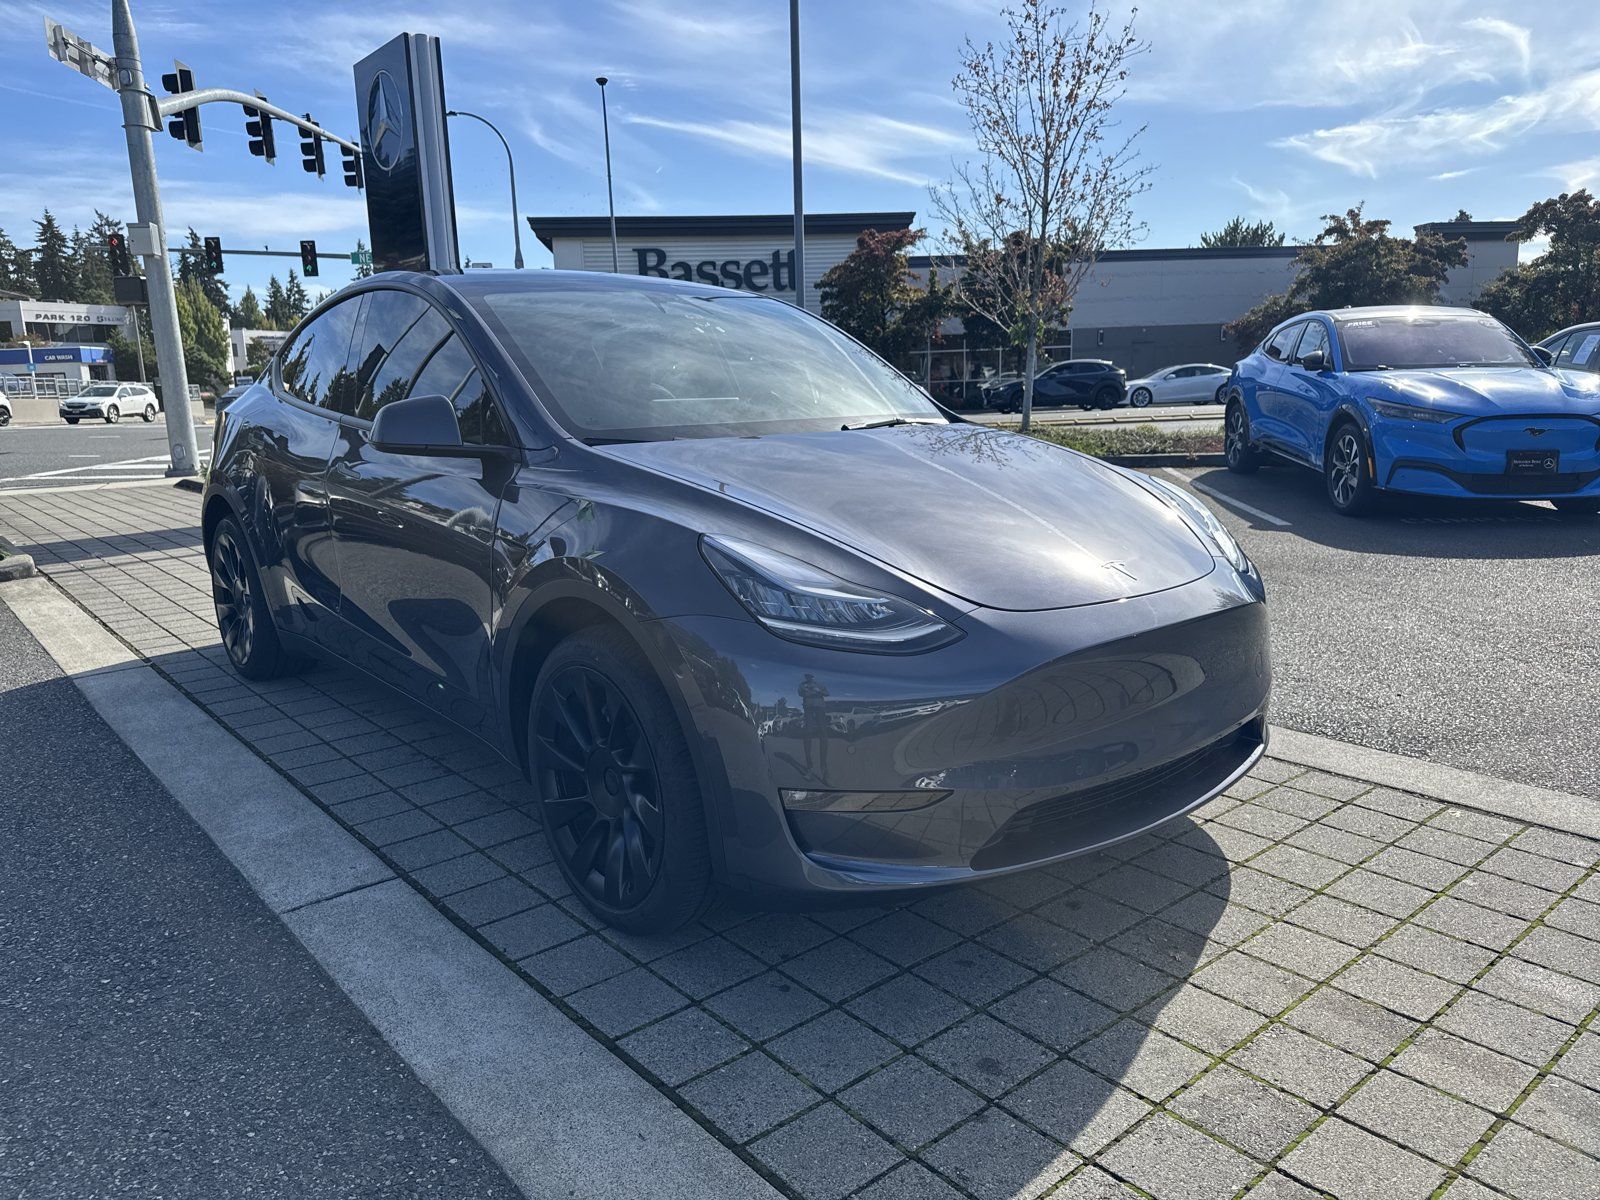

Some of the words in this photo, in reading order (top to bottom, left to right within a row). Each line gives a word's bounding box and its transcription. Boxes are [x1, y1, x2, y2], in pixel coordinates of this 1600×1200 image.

[358, 253, 373, 263] NE
[632, 248, 795, 291] Bassett
[35, 313, 65, 321] PARK
